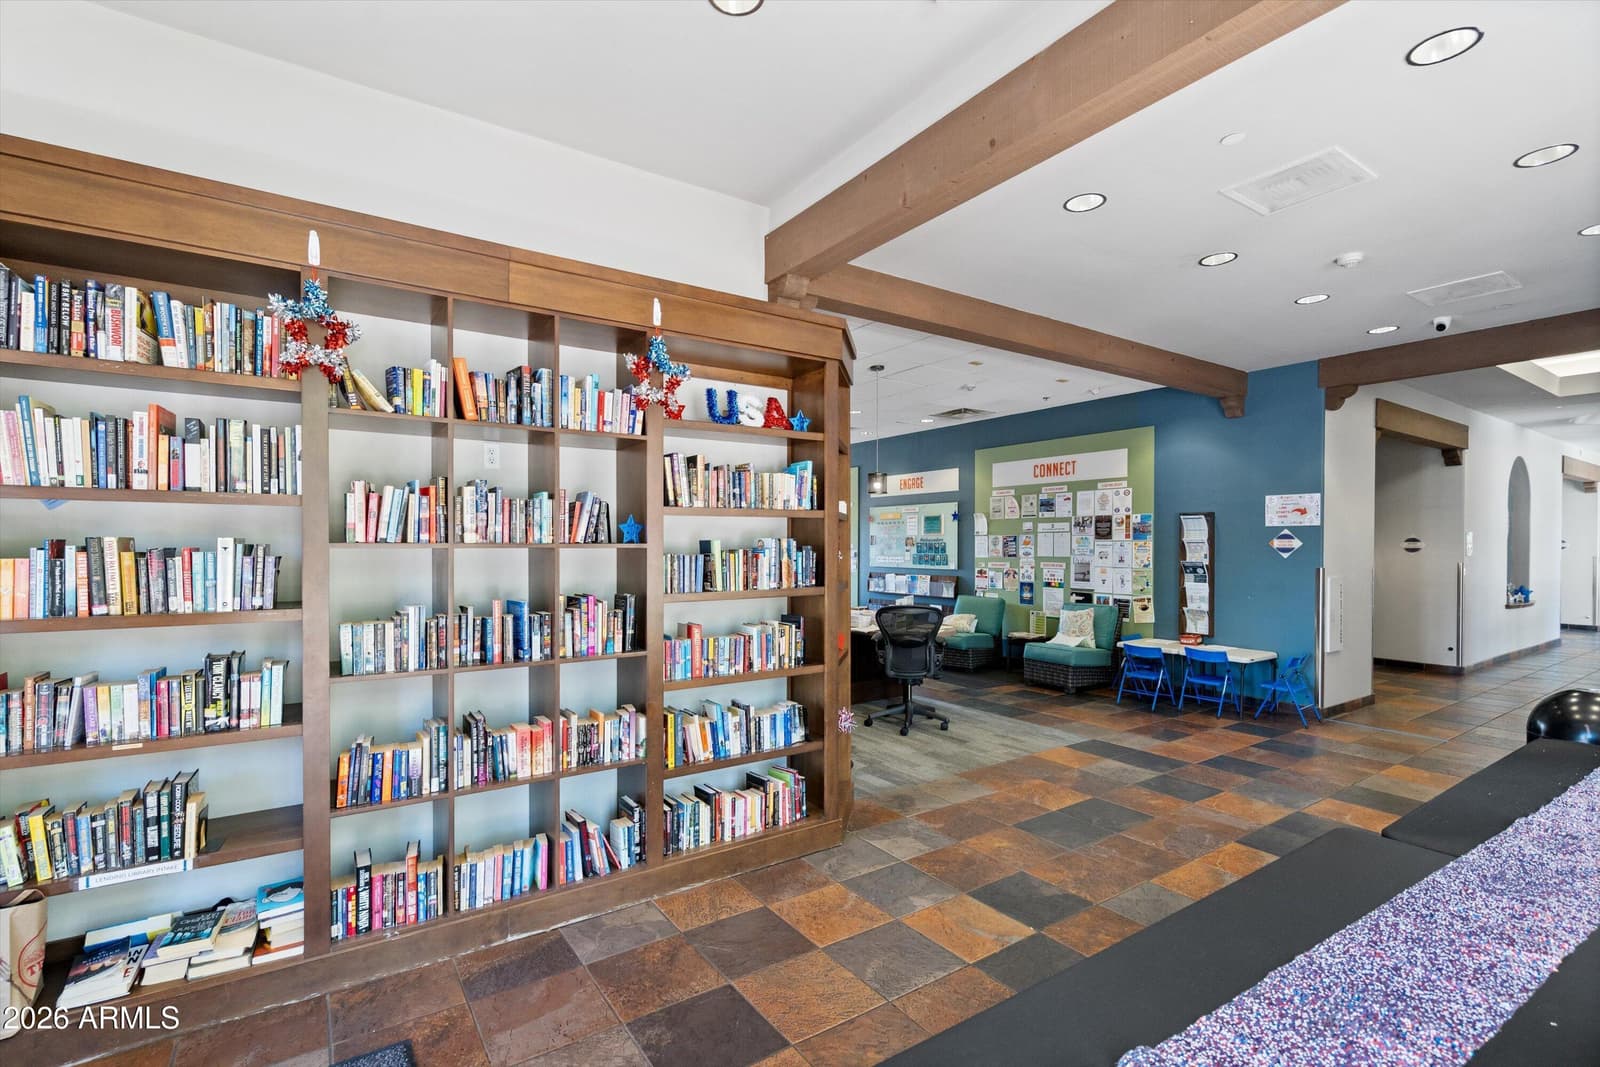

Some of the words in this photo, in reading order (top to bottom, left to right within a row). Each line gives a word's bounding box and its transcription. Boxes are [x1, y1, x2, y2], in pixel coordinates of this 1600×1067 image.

[62, 302, 70, 326] BELOW
[74, 295, 82, 321] Krakatoa
[706, 387, 792, 430] USA
[1033, 460, 1077, 479] CONNECT
[900, 476, 924, 490] ENGAGE
[213, 661, 224, 675] TOM
[212, 676, 224, 700] CLANCY
[359, 890, 369, 910] WHITE
[358, 911, 369, 929] NINJA
